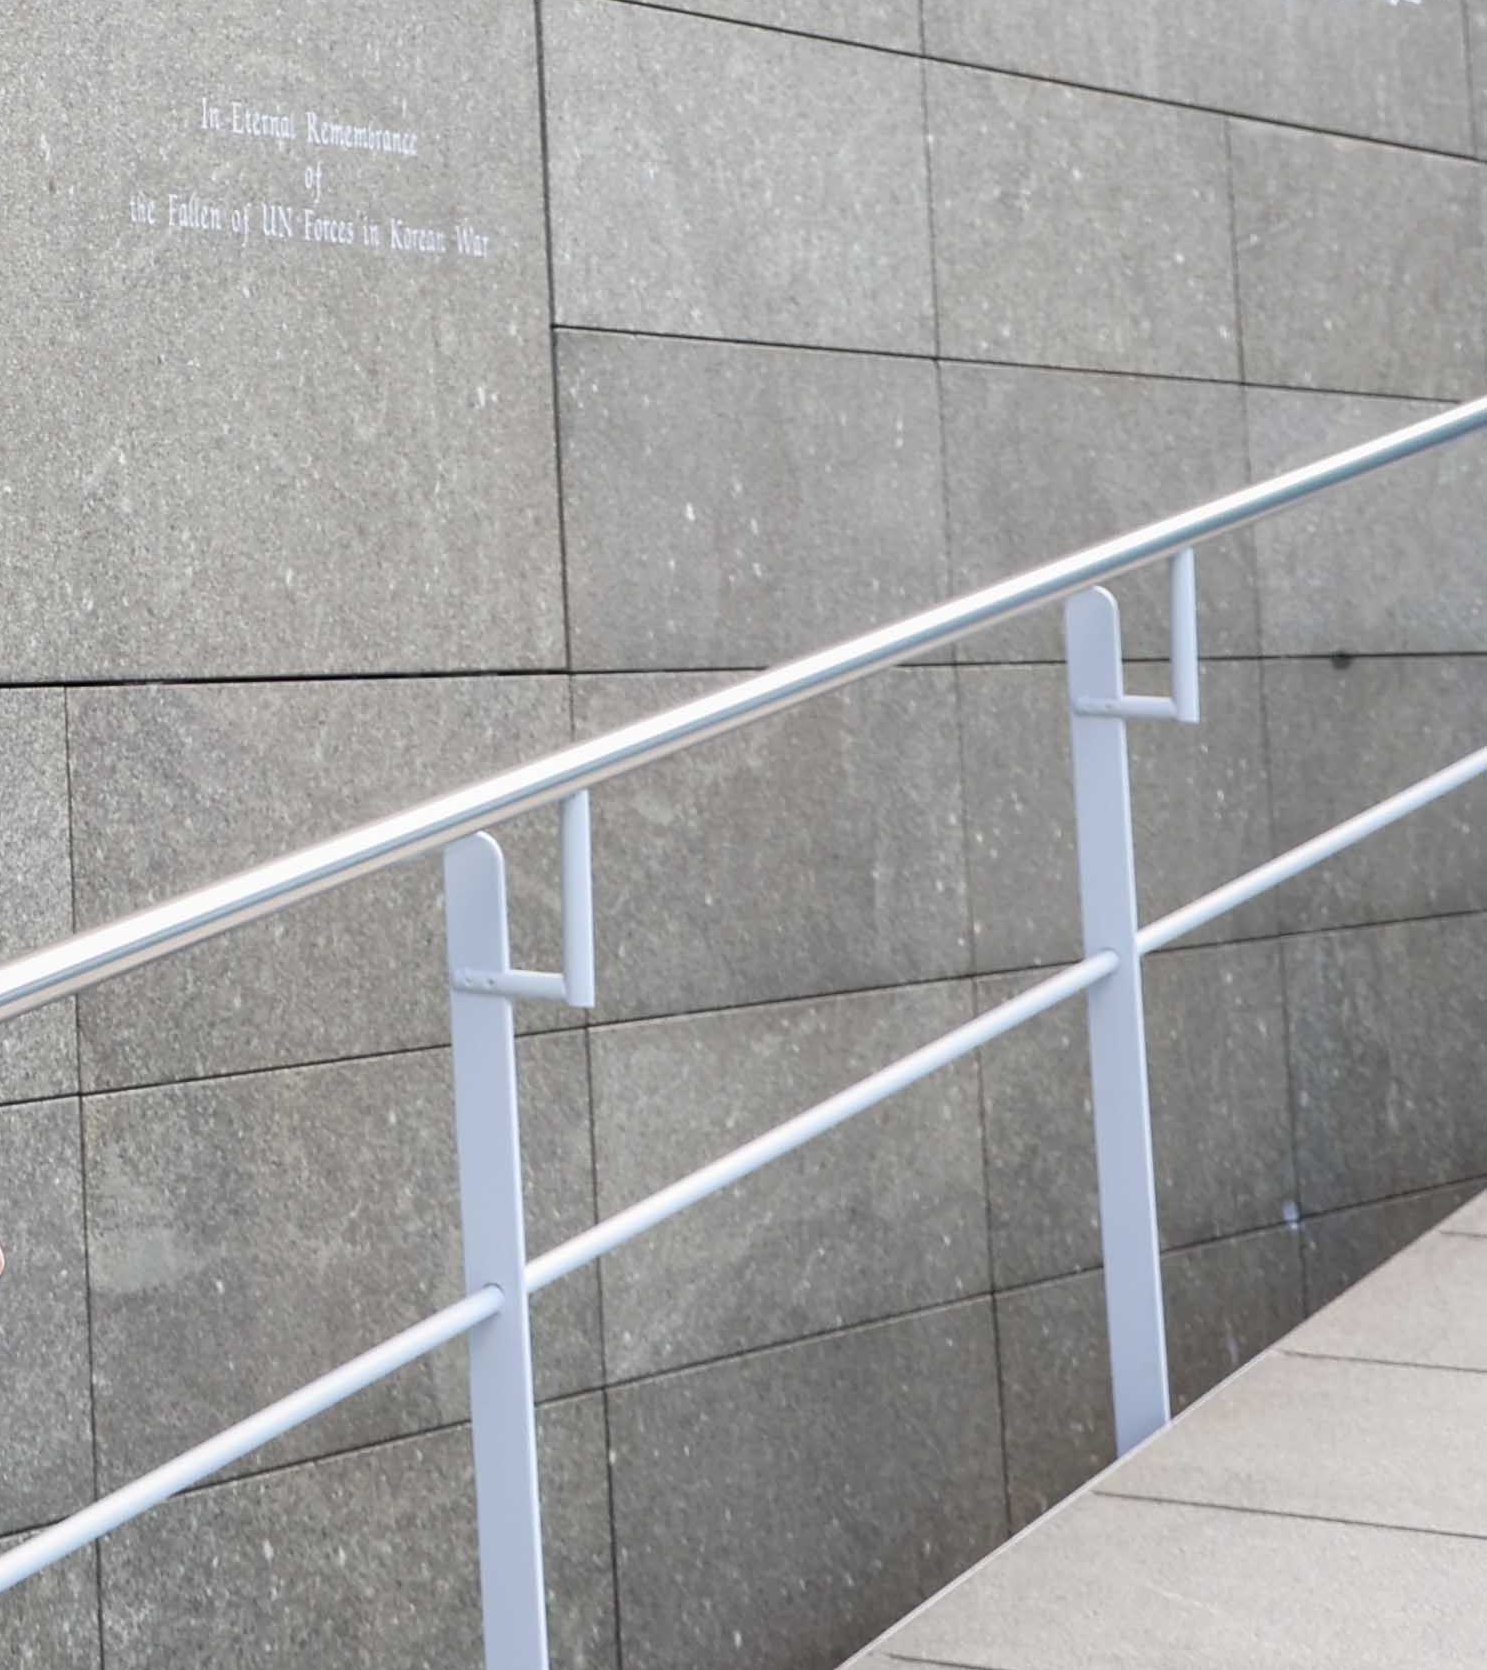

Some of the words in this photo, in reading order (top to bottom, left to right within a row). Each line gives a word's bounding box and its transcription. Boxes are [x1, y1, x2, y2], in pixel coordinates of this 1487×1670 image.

[201, 98, 225, 130] In
[232, 102, 296, 140] Eternal
[306, 111, 418, 156] Remembrance
[305, 161, 322, 204] of
[232, 202, 252, 248] of
[262, 202, 292, 238] UN
[305, 209, 354, 245] Forces
[391, 218, 446, 253] Korean
[455, 226, 489, 258] War
